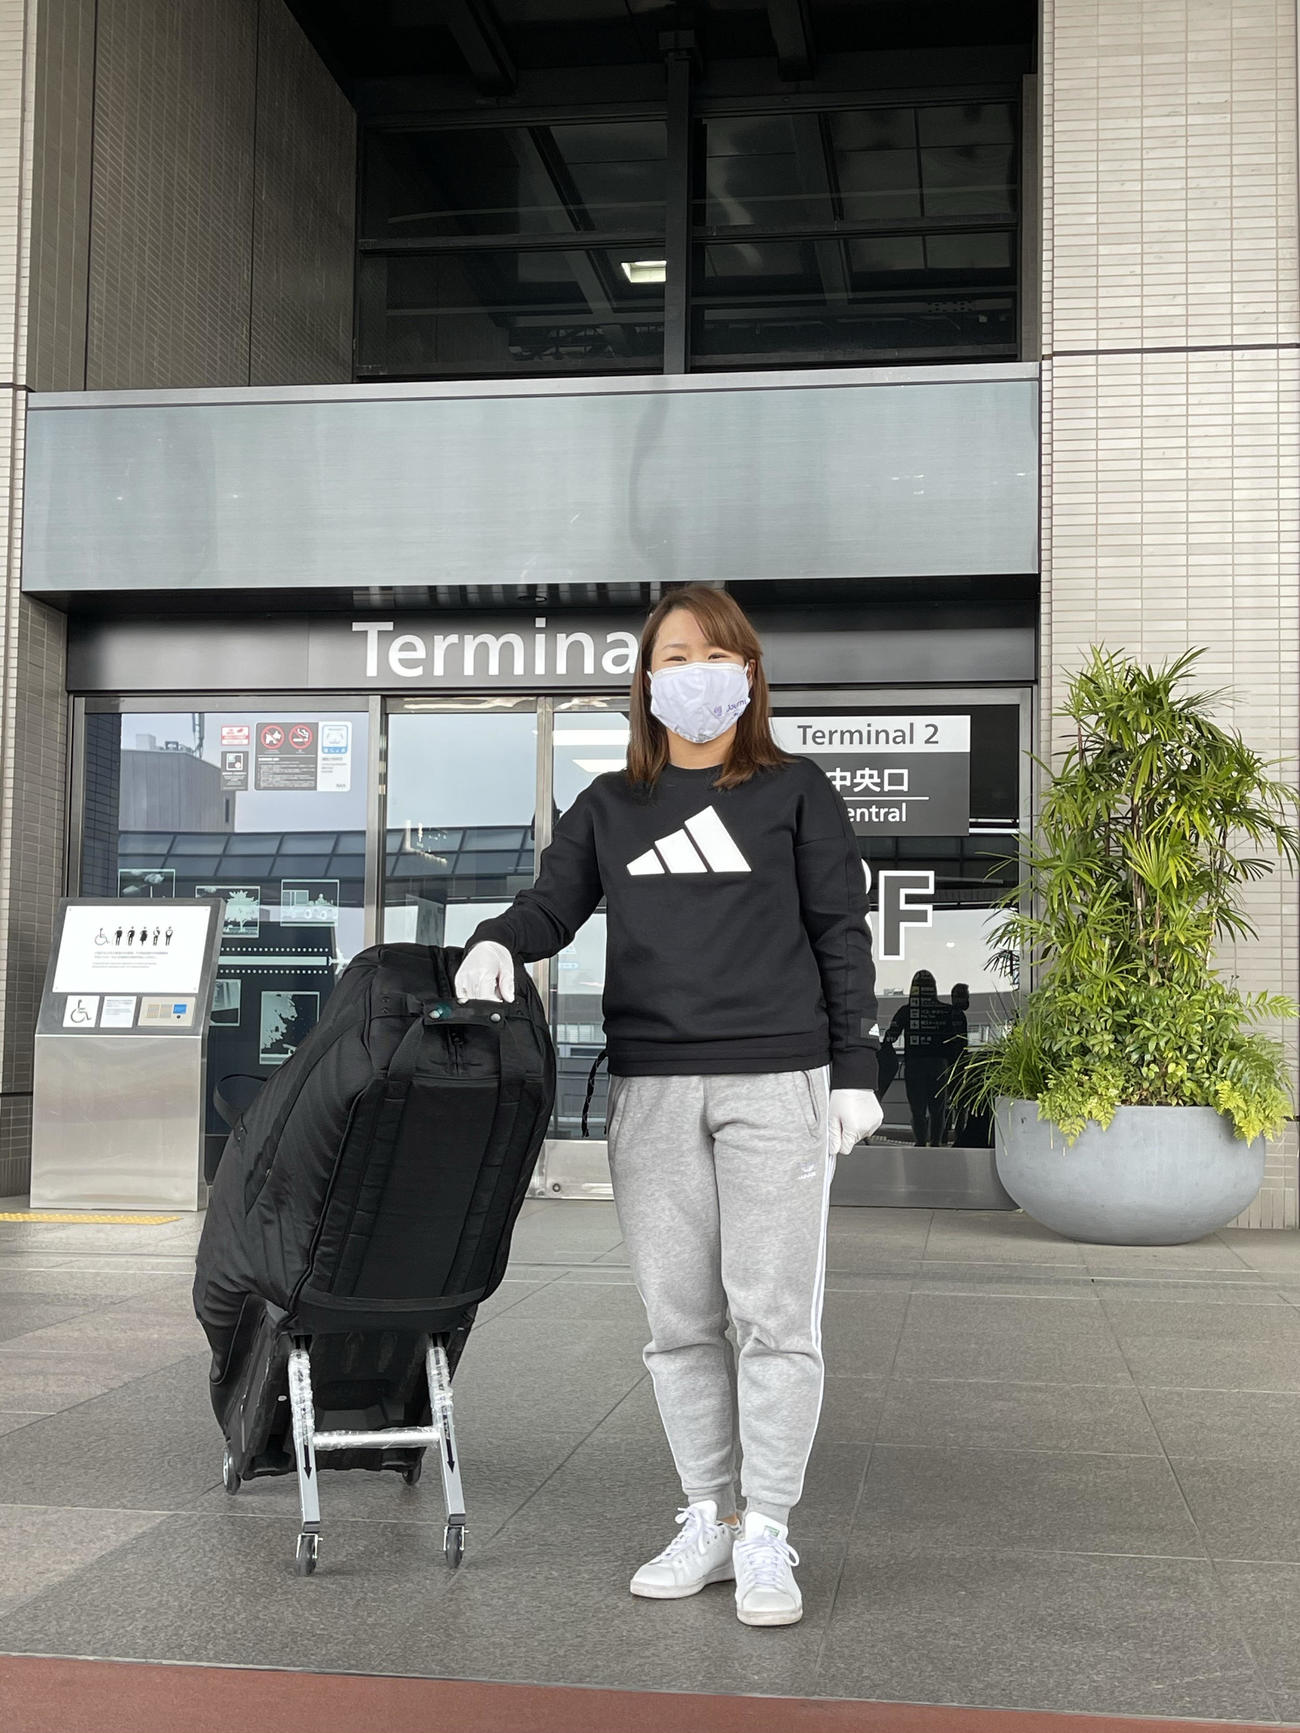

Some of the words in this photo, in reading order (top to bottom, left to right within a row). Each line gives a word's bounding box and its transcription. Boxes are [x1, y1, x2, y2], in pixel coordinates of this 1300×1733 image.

[352, 617, 639, 677] Termina
[798, 722, 914, 745] Terminal
[924, 724, 939, 744] 2
[826, 767, 908, 793] 中央口
[847, 802, 906, 822] entral
